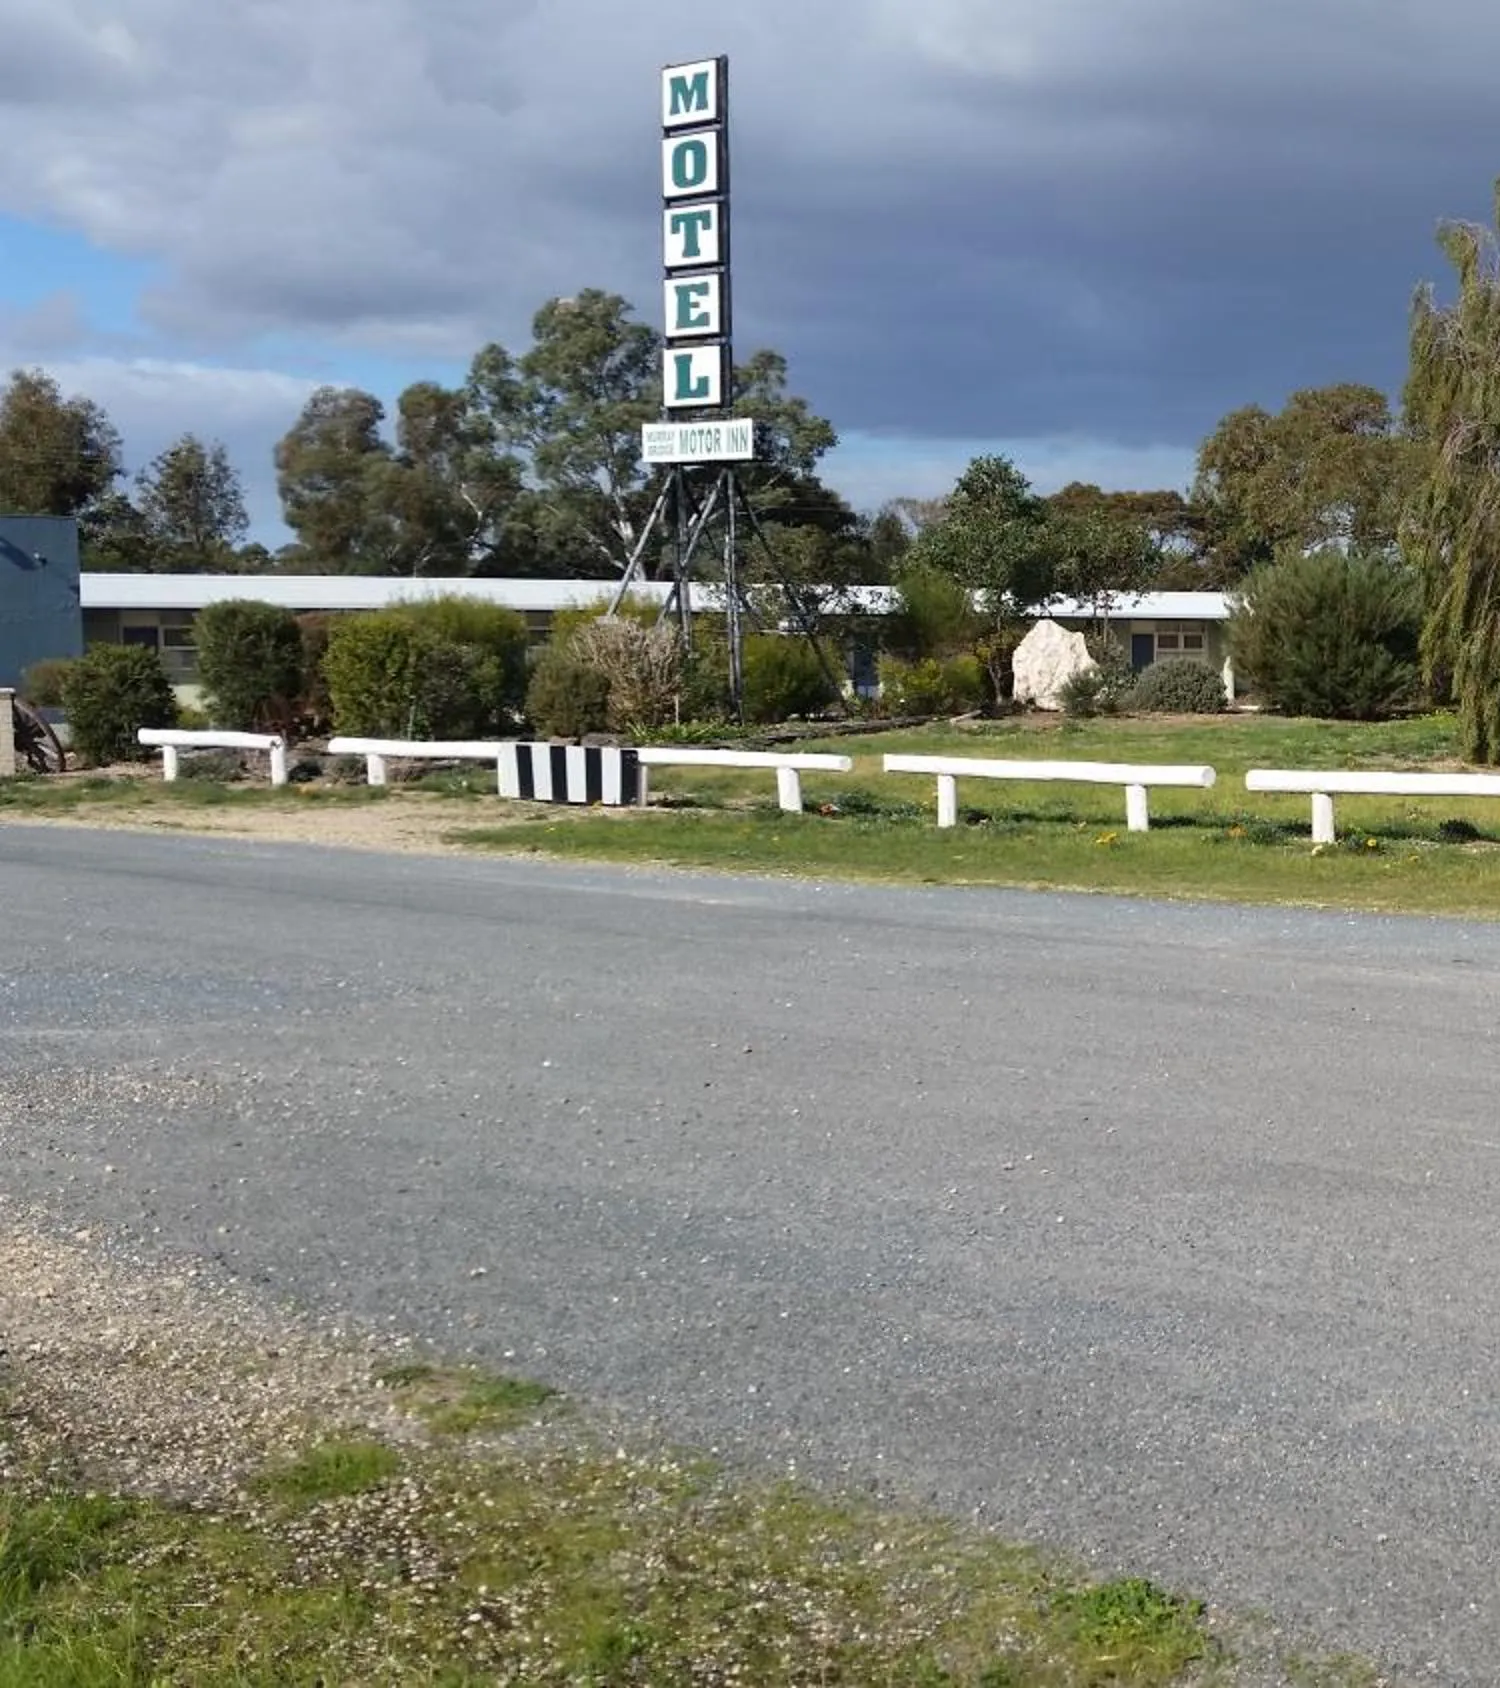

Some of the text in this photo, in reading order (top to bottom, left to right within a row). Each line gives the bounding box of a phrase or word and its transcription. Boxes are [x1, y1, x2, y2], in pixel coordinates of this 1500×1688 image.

[669, 71, 711, 400] MOTEL
[679, 424, 749, 454] MOTOR INN
